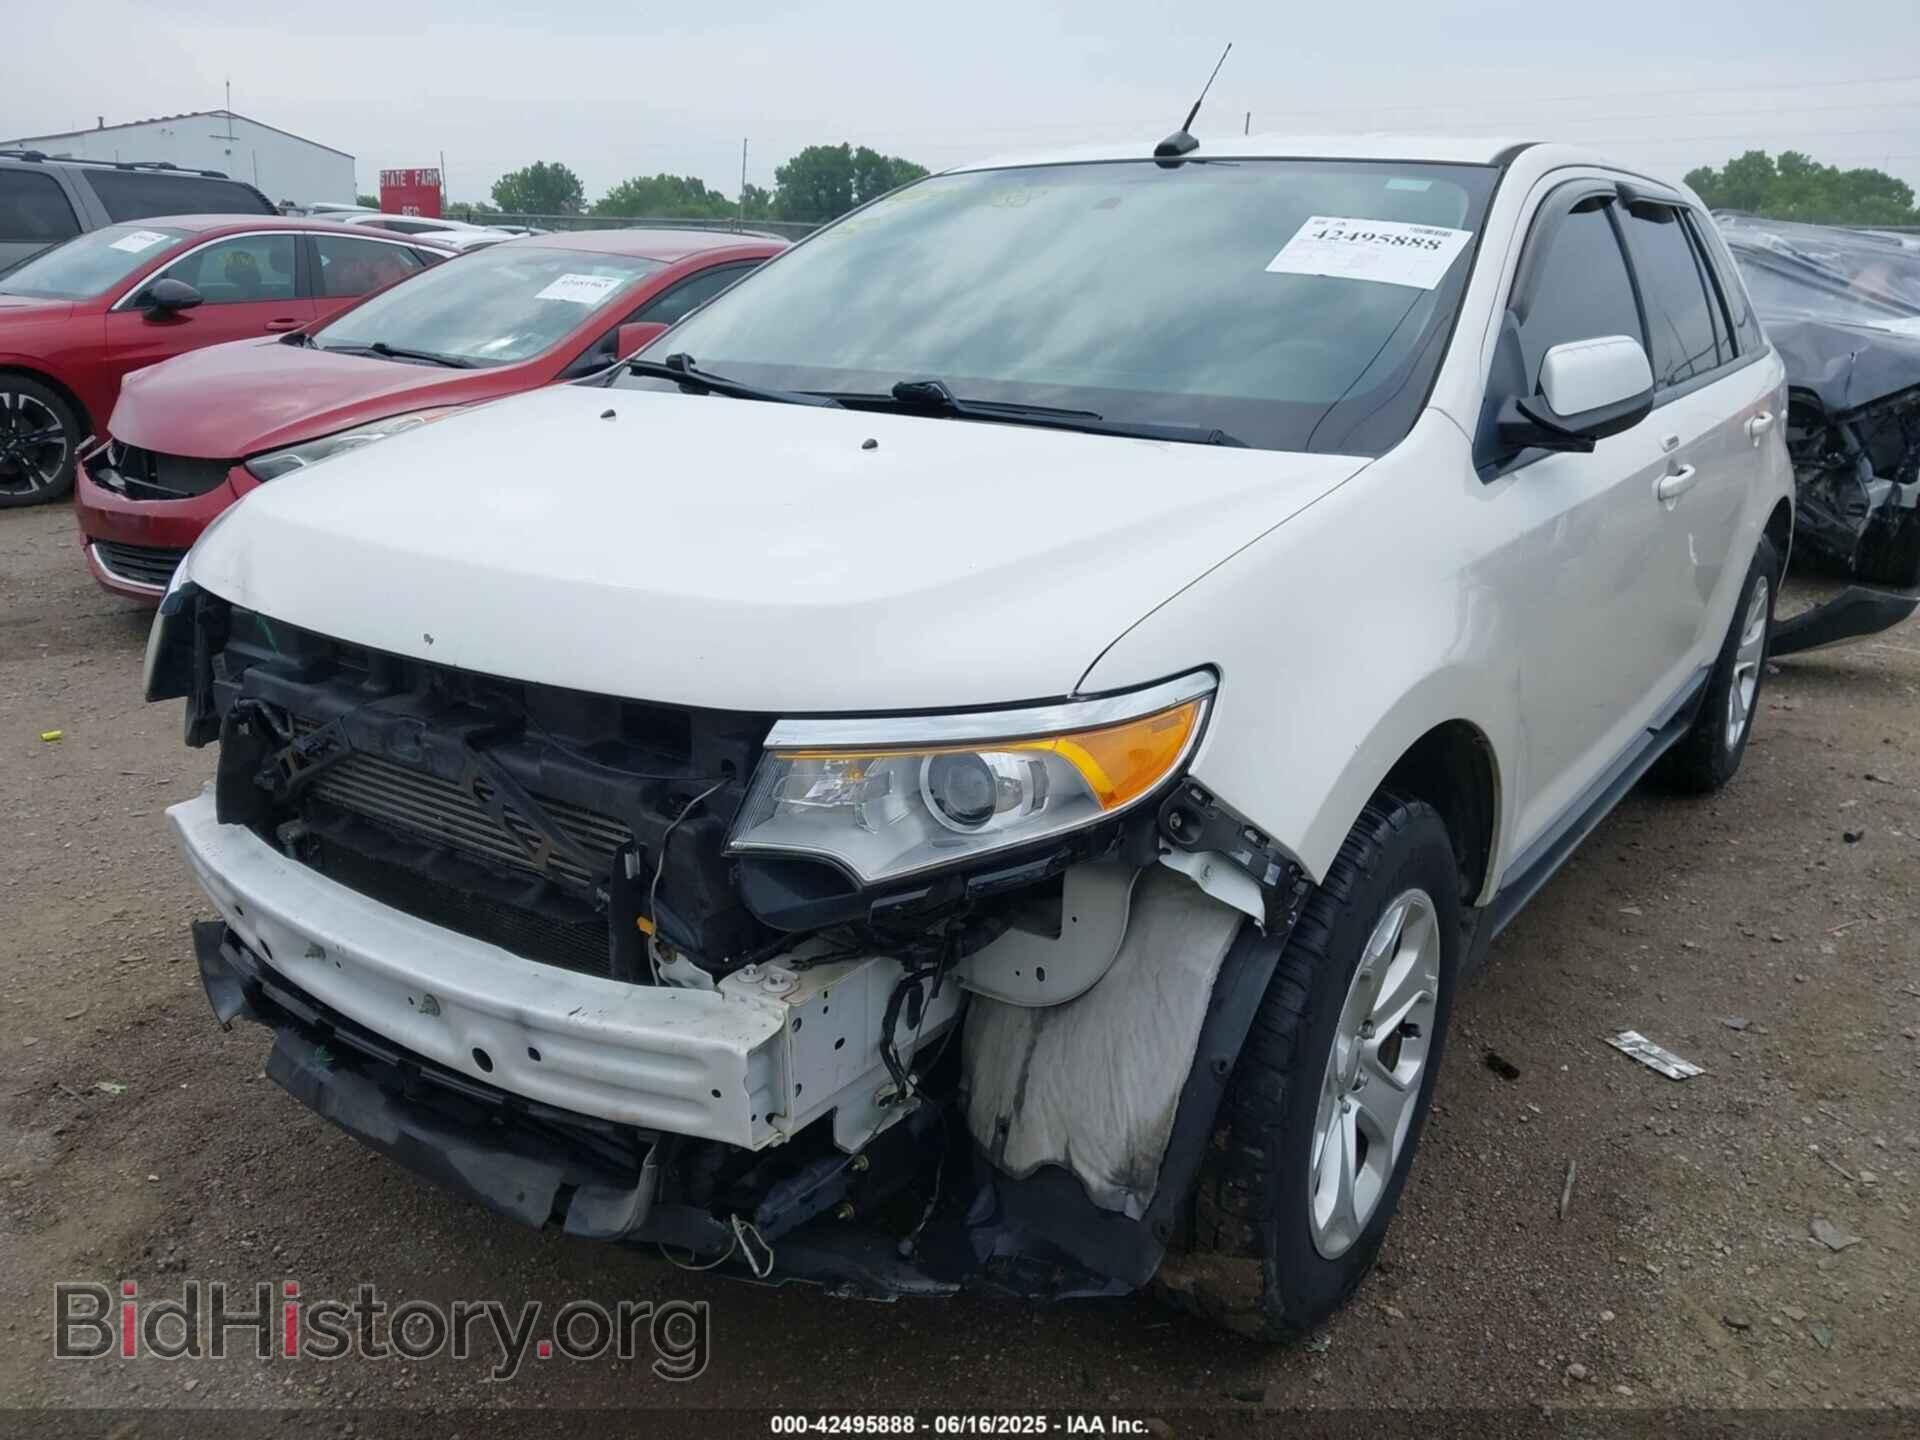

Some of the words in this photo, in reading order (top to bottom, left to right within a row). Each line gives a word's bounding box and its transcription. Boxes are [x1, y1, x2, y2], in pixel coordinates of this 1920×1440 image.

[380, 170, 407, 188] STATE
[415, 169, 440, 187] FARM
[1312, 228, 1442, 251] 42495888
